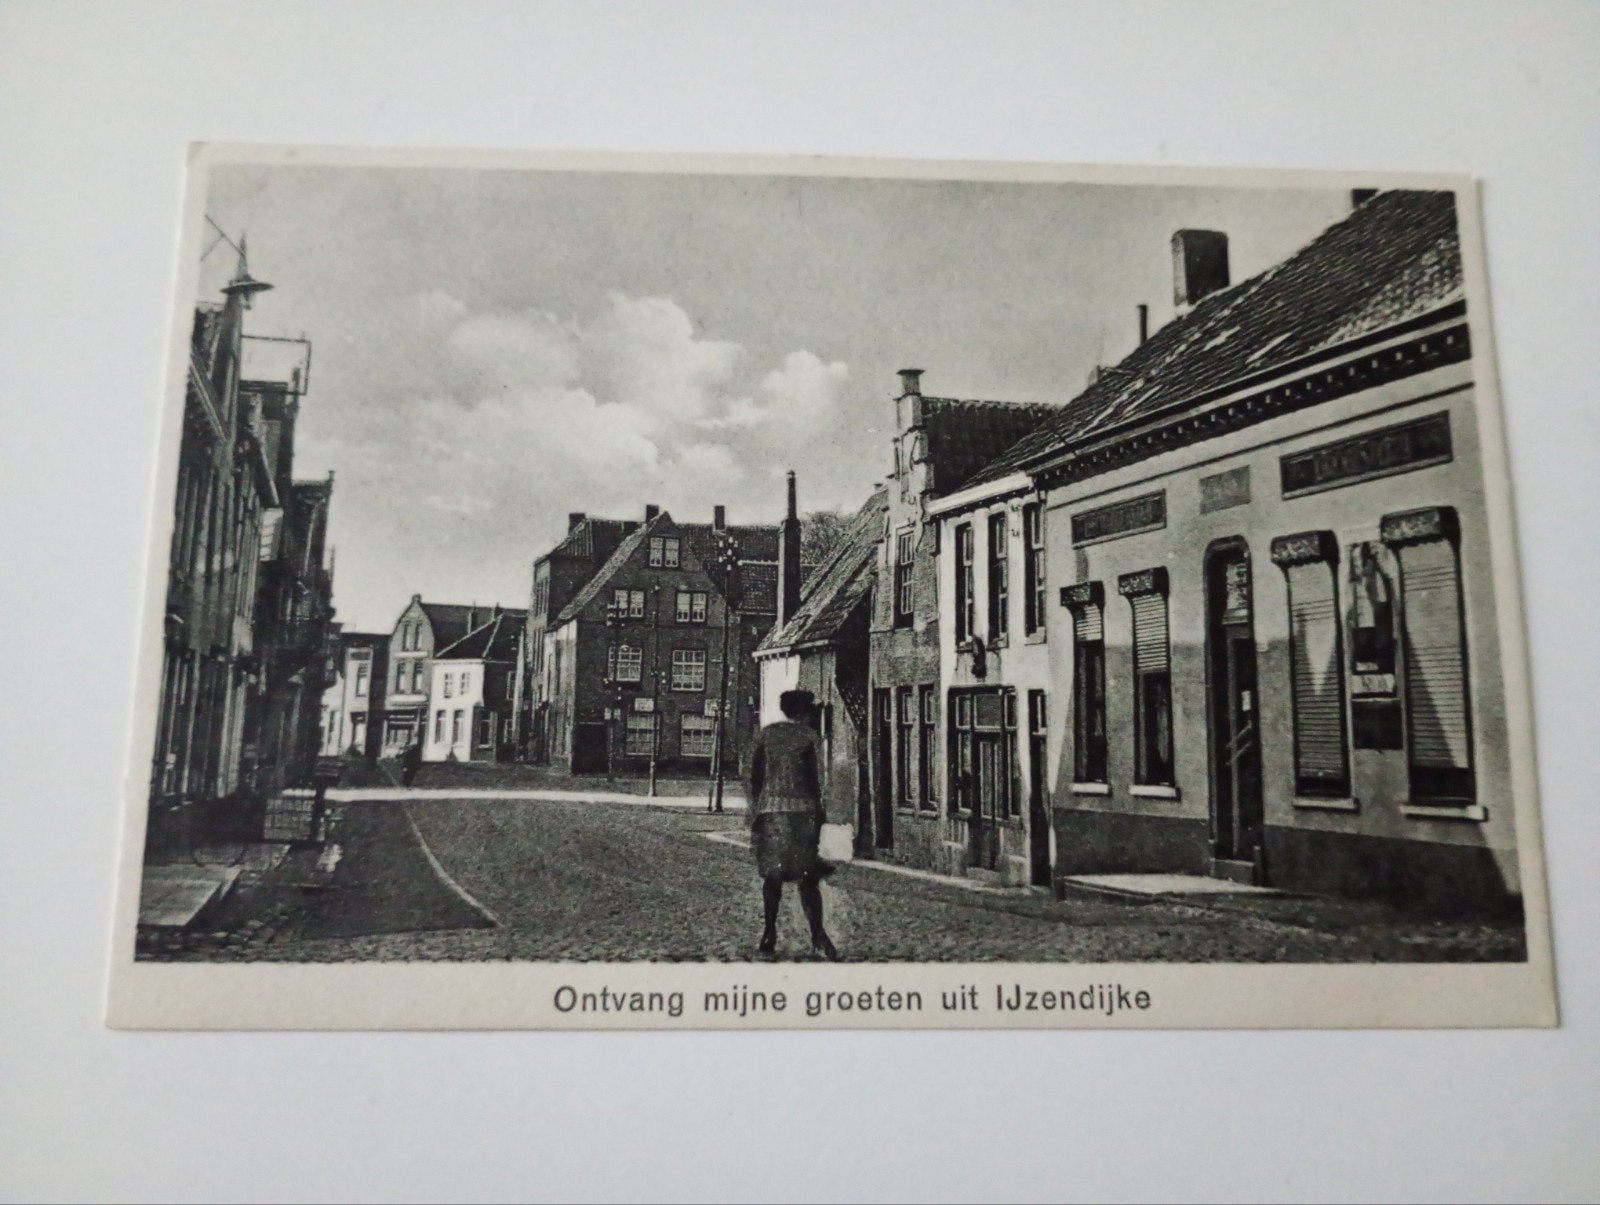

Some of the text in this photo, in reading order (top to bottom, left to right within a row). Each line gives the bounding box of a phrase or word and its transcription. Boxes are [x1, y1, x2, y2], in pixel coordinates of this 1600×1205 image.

[554, 984, 1151, 1017] Ontvang mijne groeten uit IJzendijke
